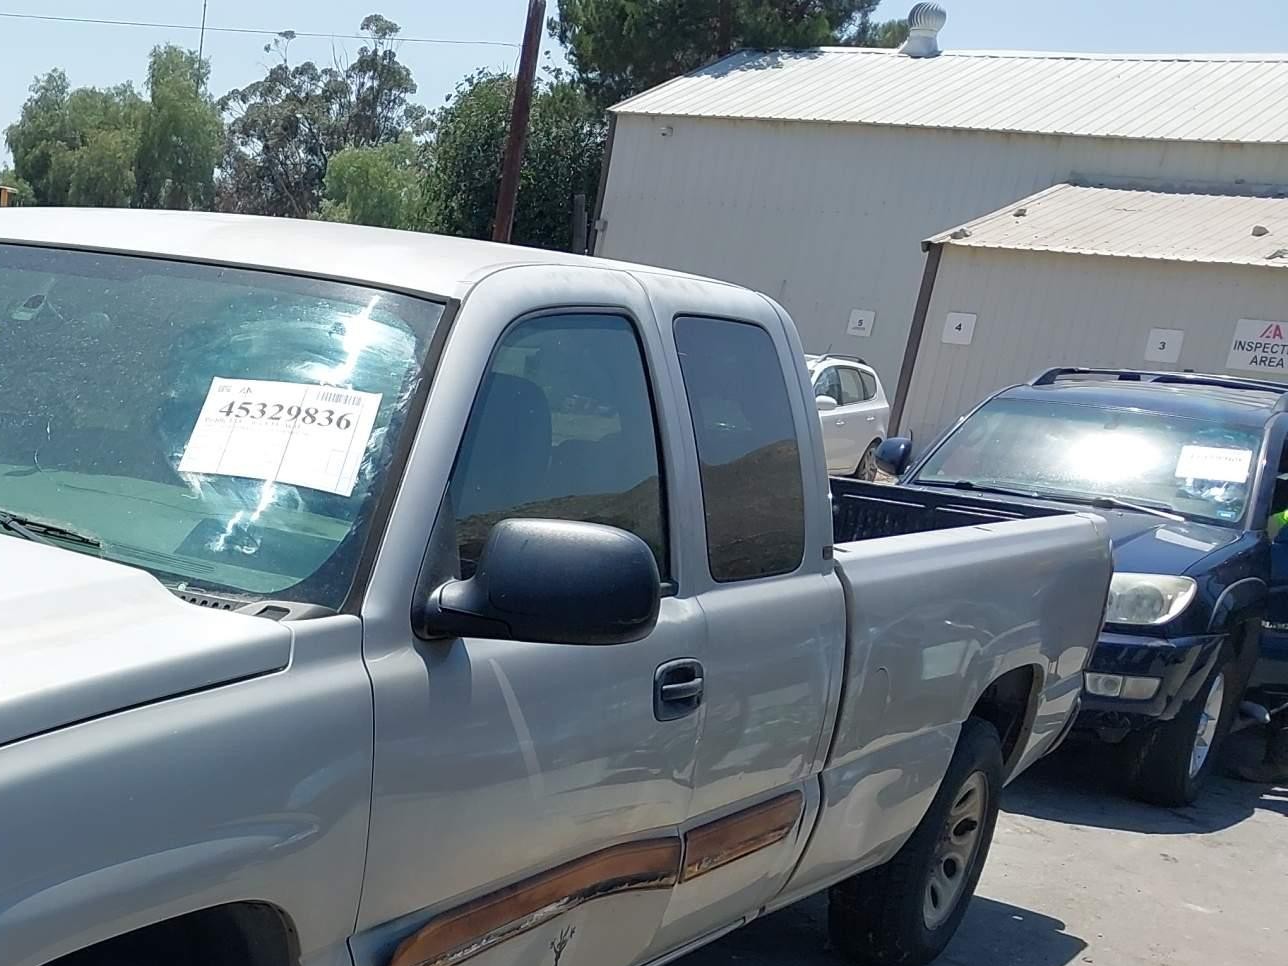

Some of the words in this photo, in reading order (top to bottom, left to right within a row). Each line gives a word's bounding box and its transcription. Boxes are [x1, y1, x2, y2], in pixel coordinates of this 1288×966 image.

[954, 322, 962, 331] 4
[1158, 341, 1166, 351] 3
[1233, 340, 1288, 355] INSPECT
[1249, 354, 1284, 369] AREA
[218, 400, 352, 431] 45329836
